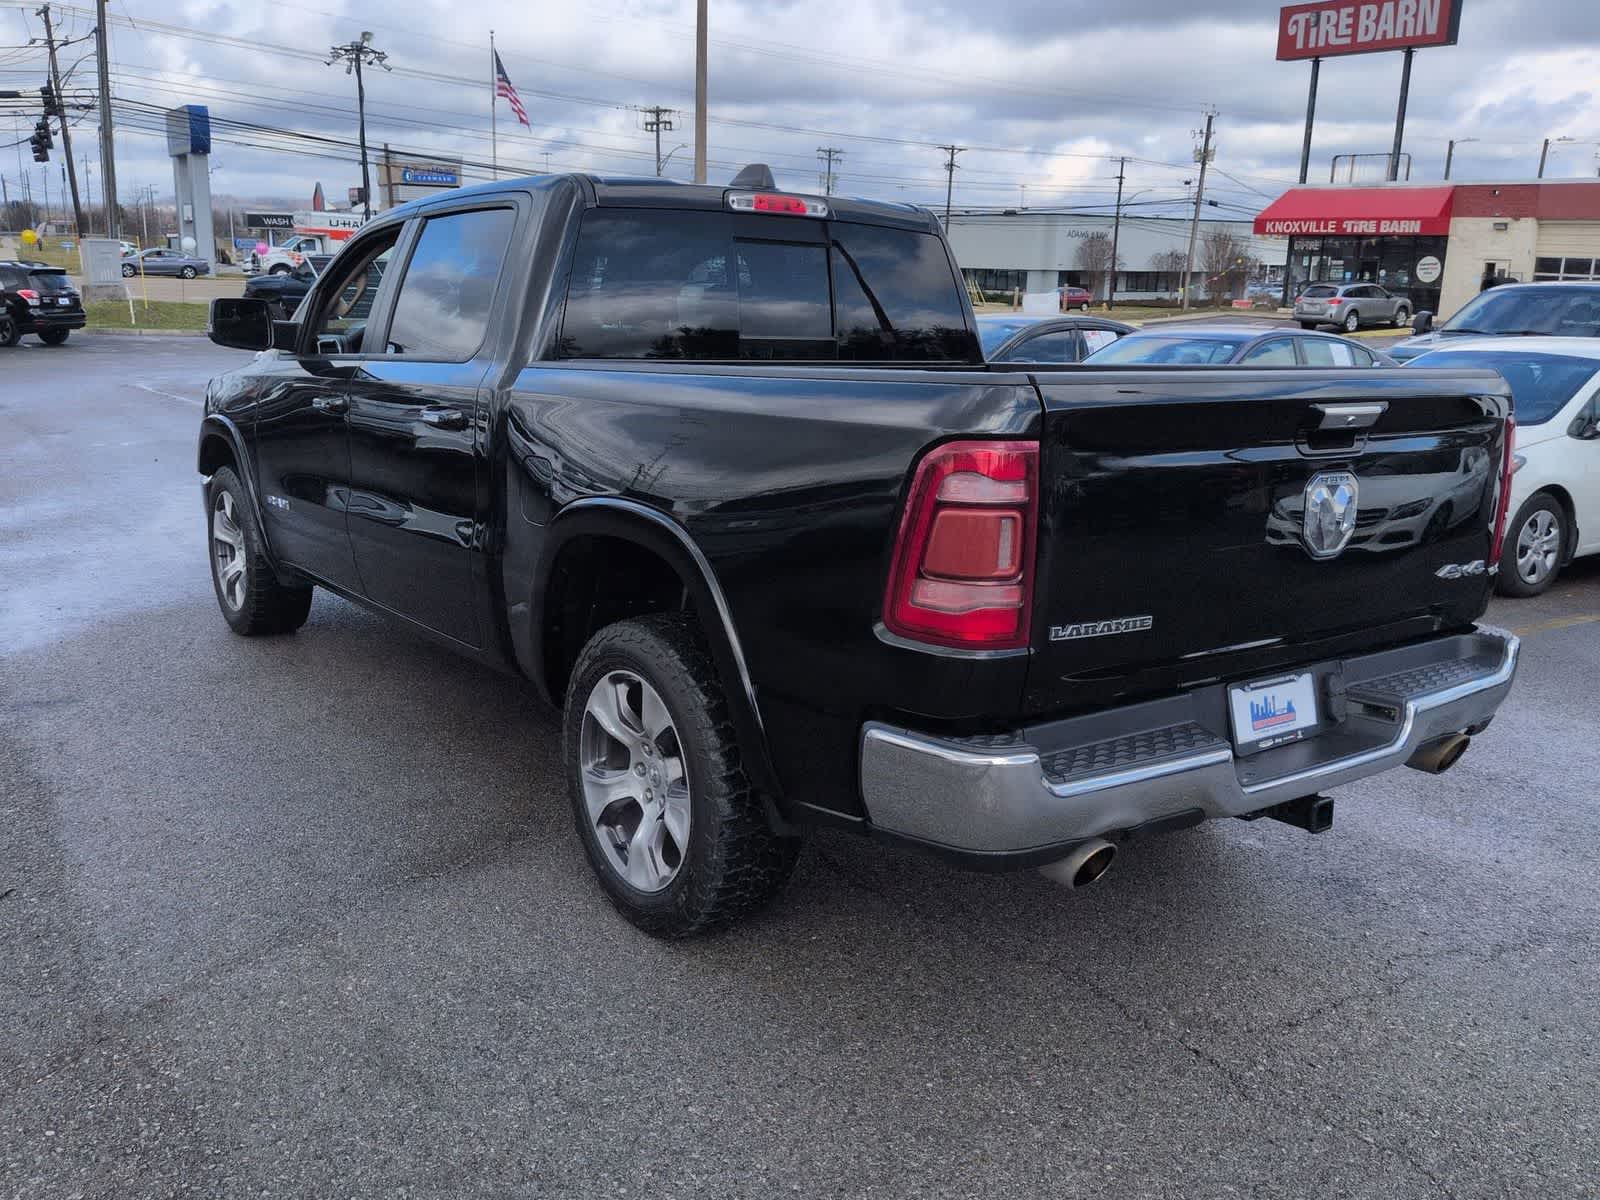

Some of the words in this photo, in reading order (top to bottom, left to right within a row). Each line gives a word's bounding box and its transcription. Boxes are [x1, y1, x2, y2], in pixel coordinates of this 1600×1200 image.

[1356, 0, 1441, 43] BARN
[262, 217, 289, 226] WASH
[1265, 220, 1337, 233] KNOXVILLE
[1379, 220, 1421, 233] BARN
[1049, 615, 1153, 641] LARAMIE
